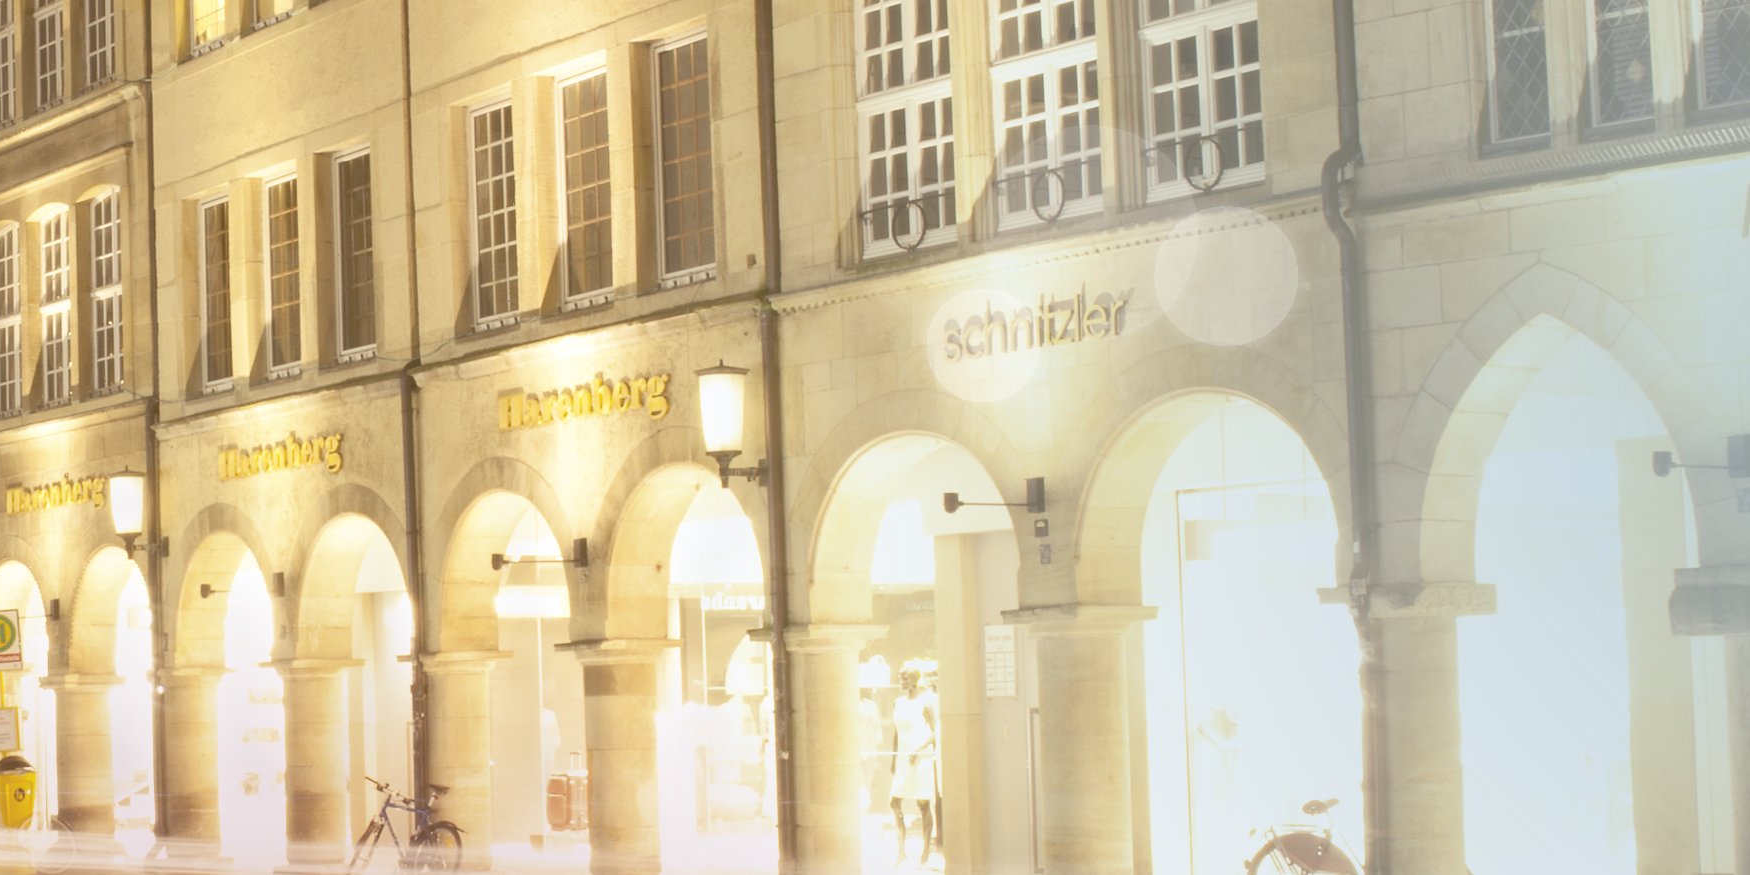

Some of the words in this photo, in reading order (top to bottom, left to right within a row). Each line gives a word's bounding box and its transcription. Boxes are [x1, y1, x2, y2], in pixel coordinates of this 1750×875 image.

[944, 291, 1128, 362] schnitzler
[498, 373, 671, 431] Harenberg
[217, 432, 343, 480] Harenberg
[6, 475, 107, 515] Harenberg
